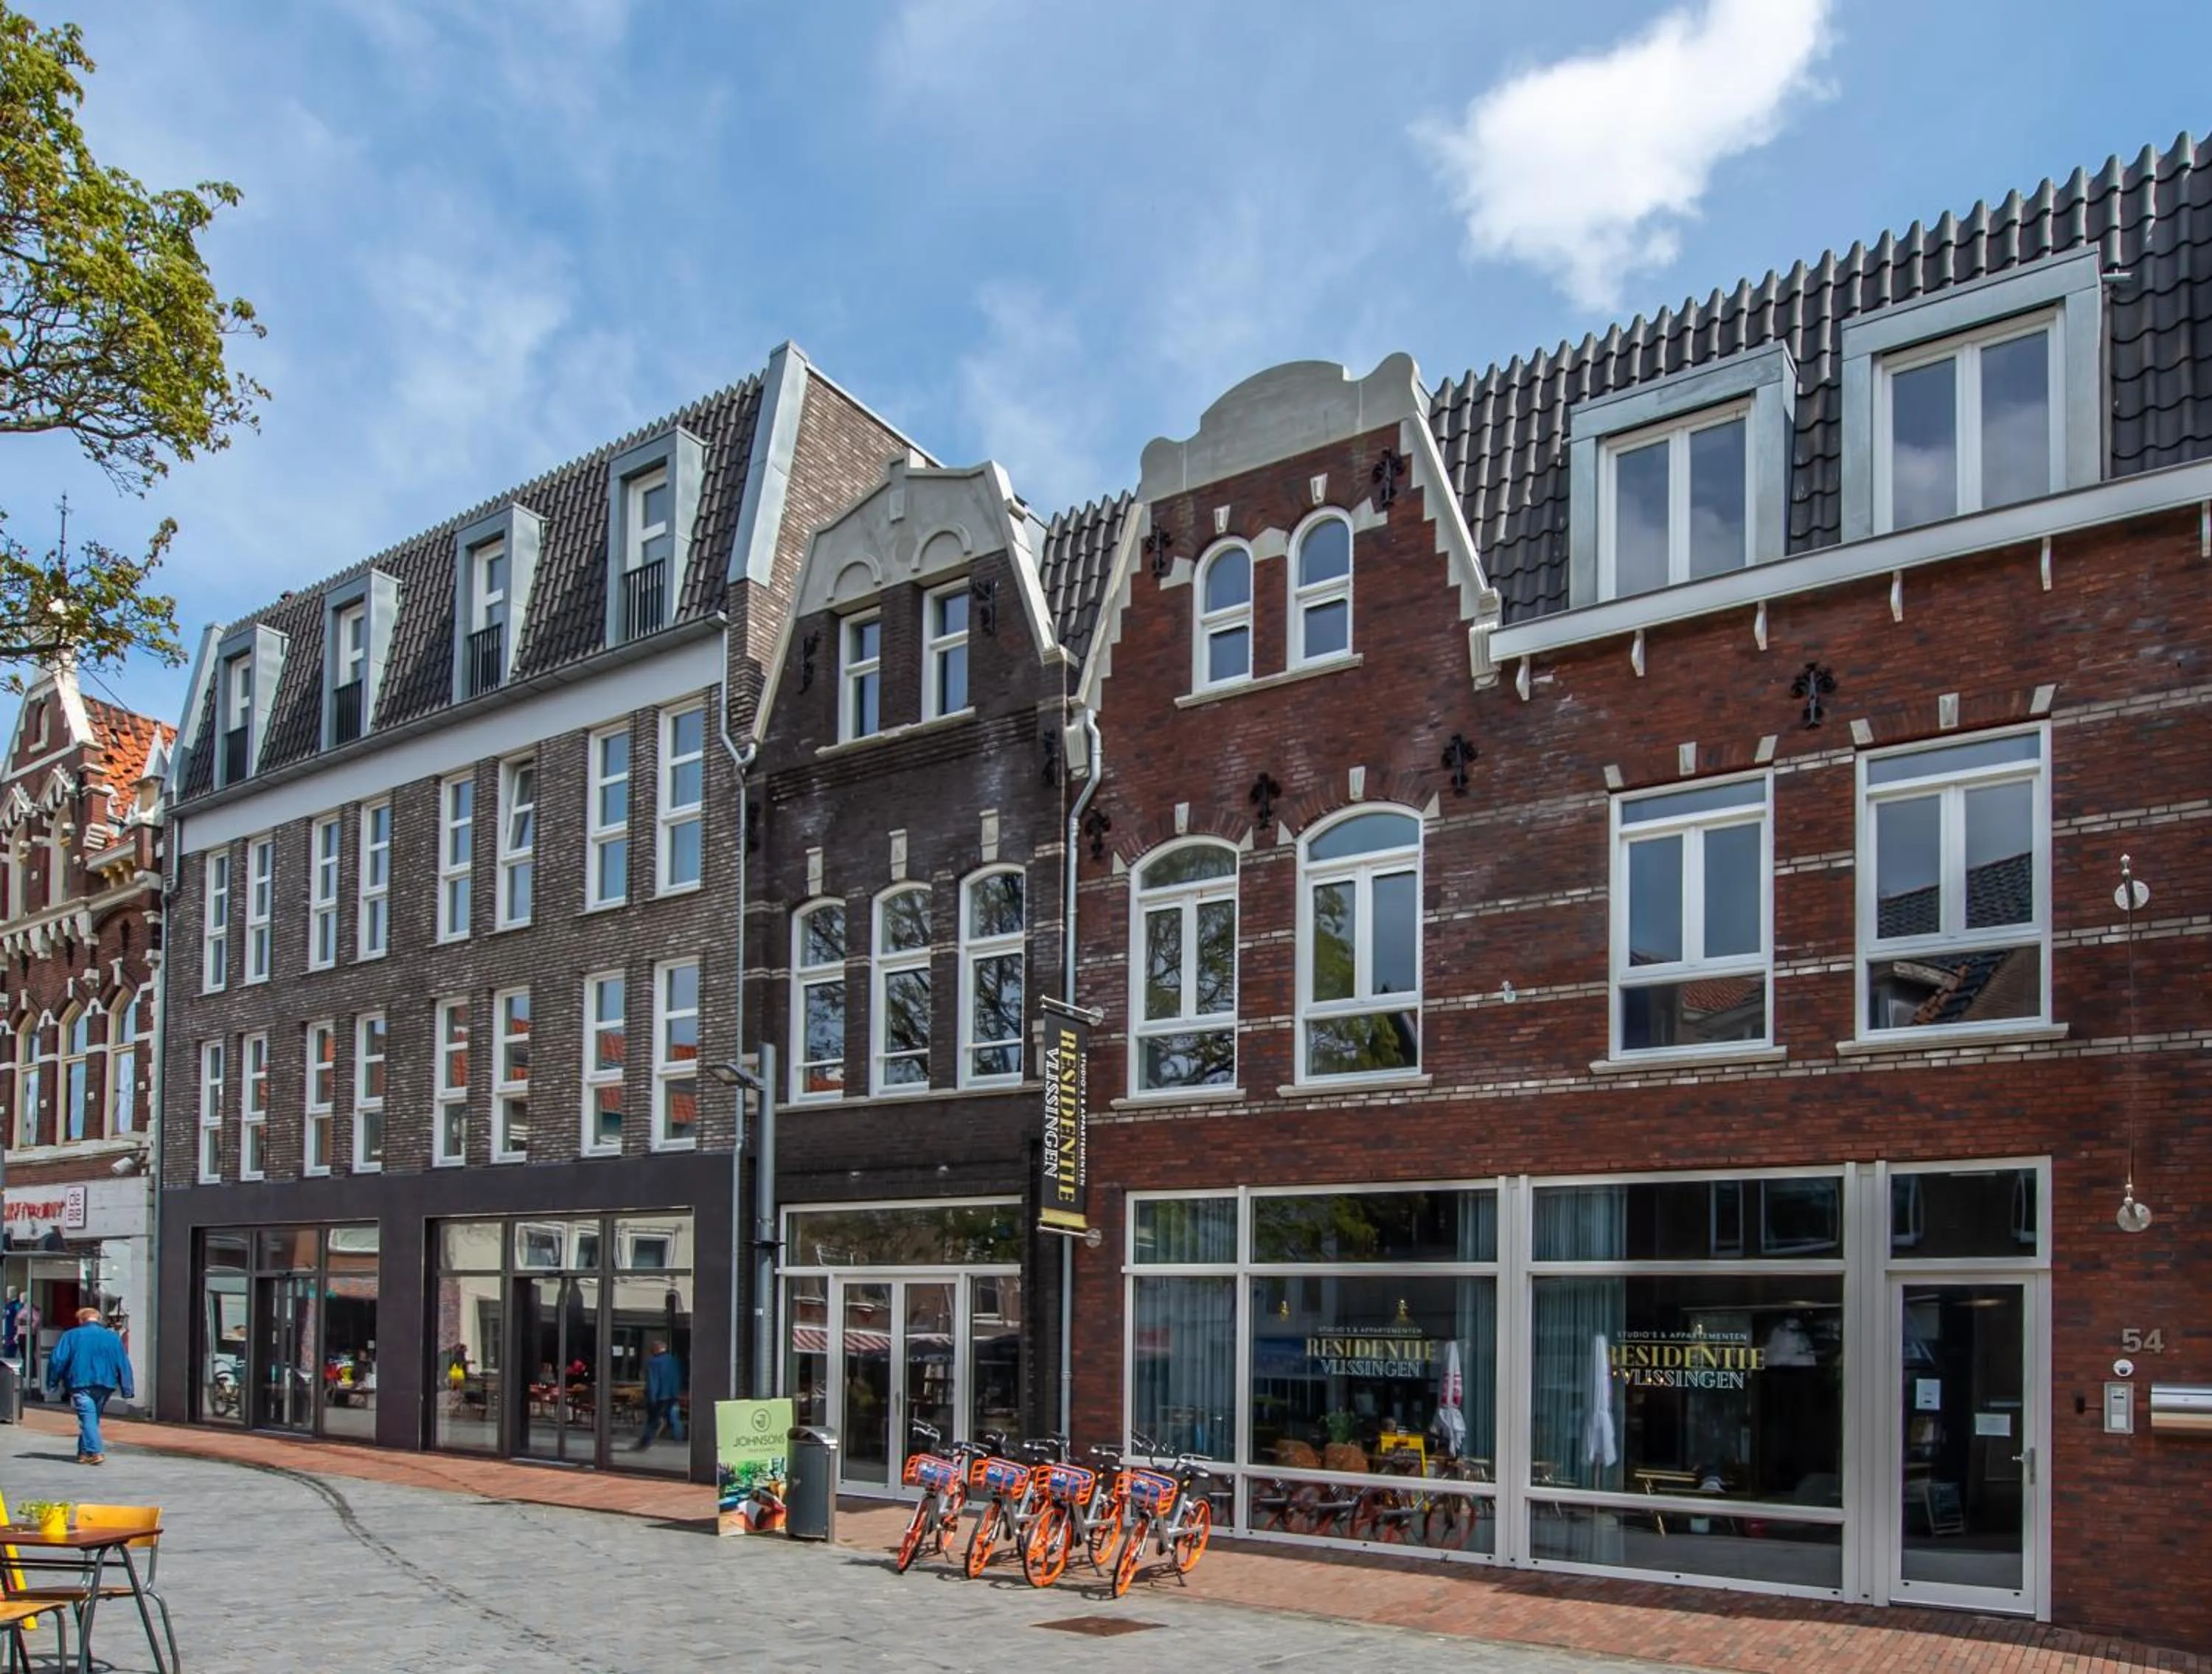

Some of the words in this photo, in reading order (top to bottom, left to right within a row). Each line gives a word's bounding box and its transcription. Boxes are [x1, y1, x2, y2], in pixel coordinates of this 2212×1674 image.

[1044, 1048, 1060, 1178] VLISSINGEN
[1058, 1029, 1077, 1203] RESIDENTIE
[1307, 1338, 1437, 1361] RESIDENTIE
[2122, 1328, 2165, 1354] 54
[1321, 1359, 1420, 1378] VLISSINGEN
[1621, 1368, 1745, 1390] VLISSINGEN
